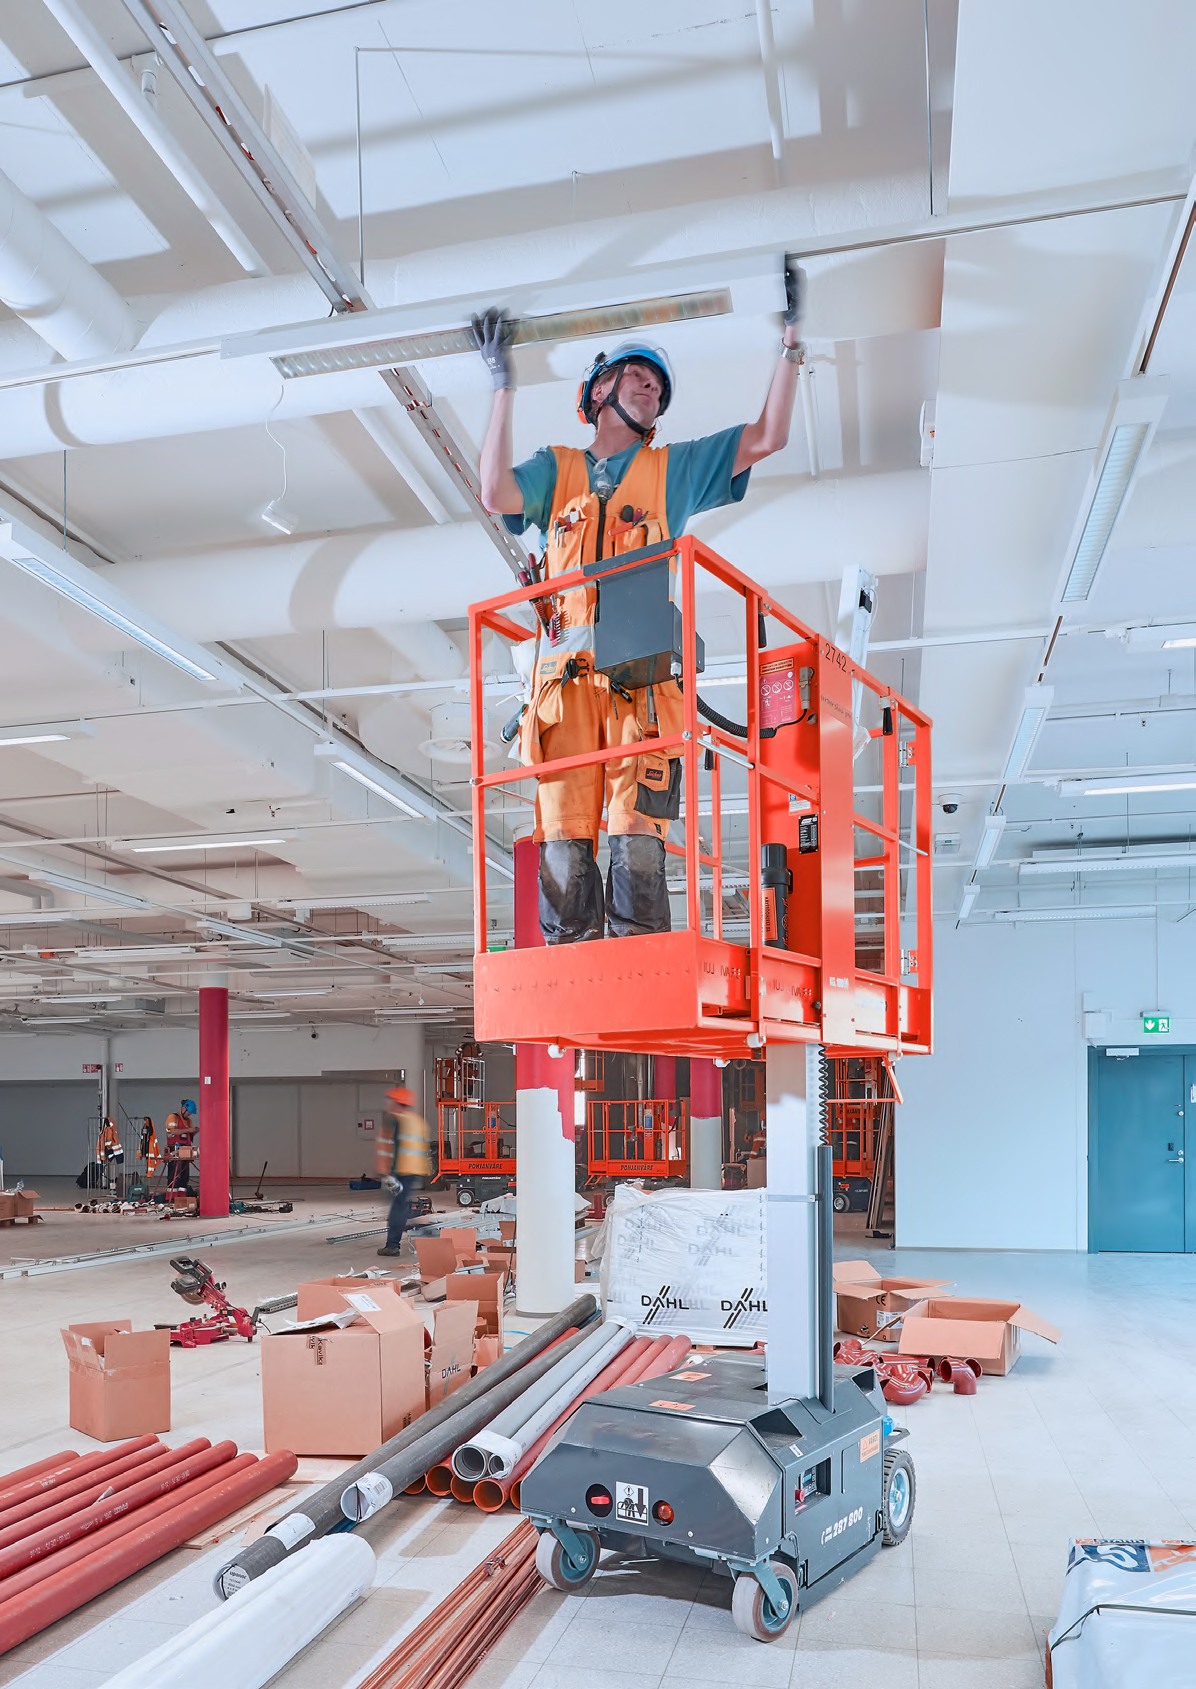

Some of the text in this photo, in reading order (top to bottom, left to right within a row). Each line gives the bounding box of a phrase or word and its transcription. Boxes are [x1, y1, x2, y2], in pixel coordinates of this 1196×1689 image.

[826, 642, 847, 673] 2742
[641, 1295, 689, 1310] DAHL
[721, 1300, 768, 1312] DAHL
[441, 1364, 461, 1379] DAHL
[833, 1519, 848, 1537] 287
[848, 1507, 863, 1527] 800
